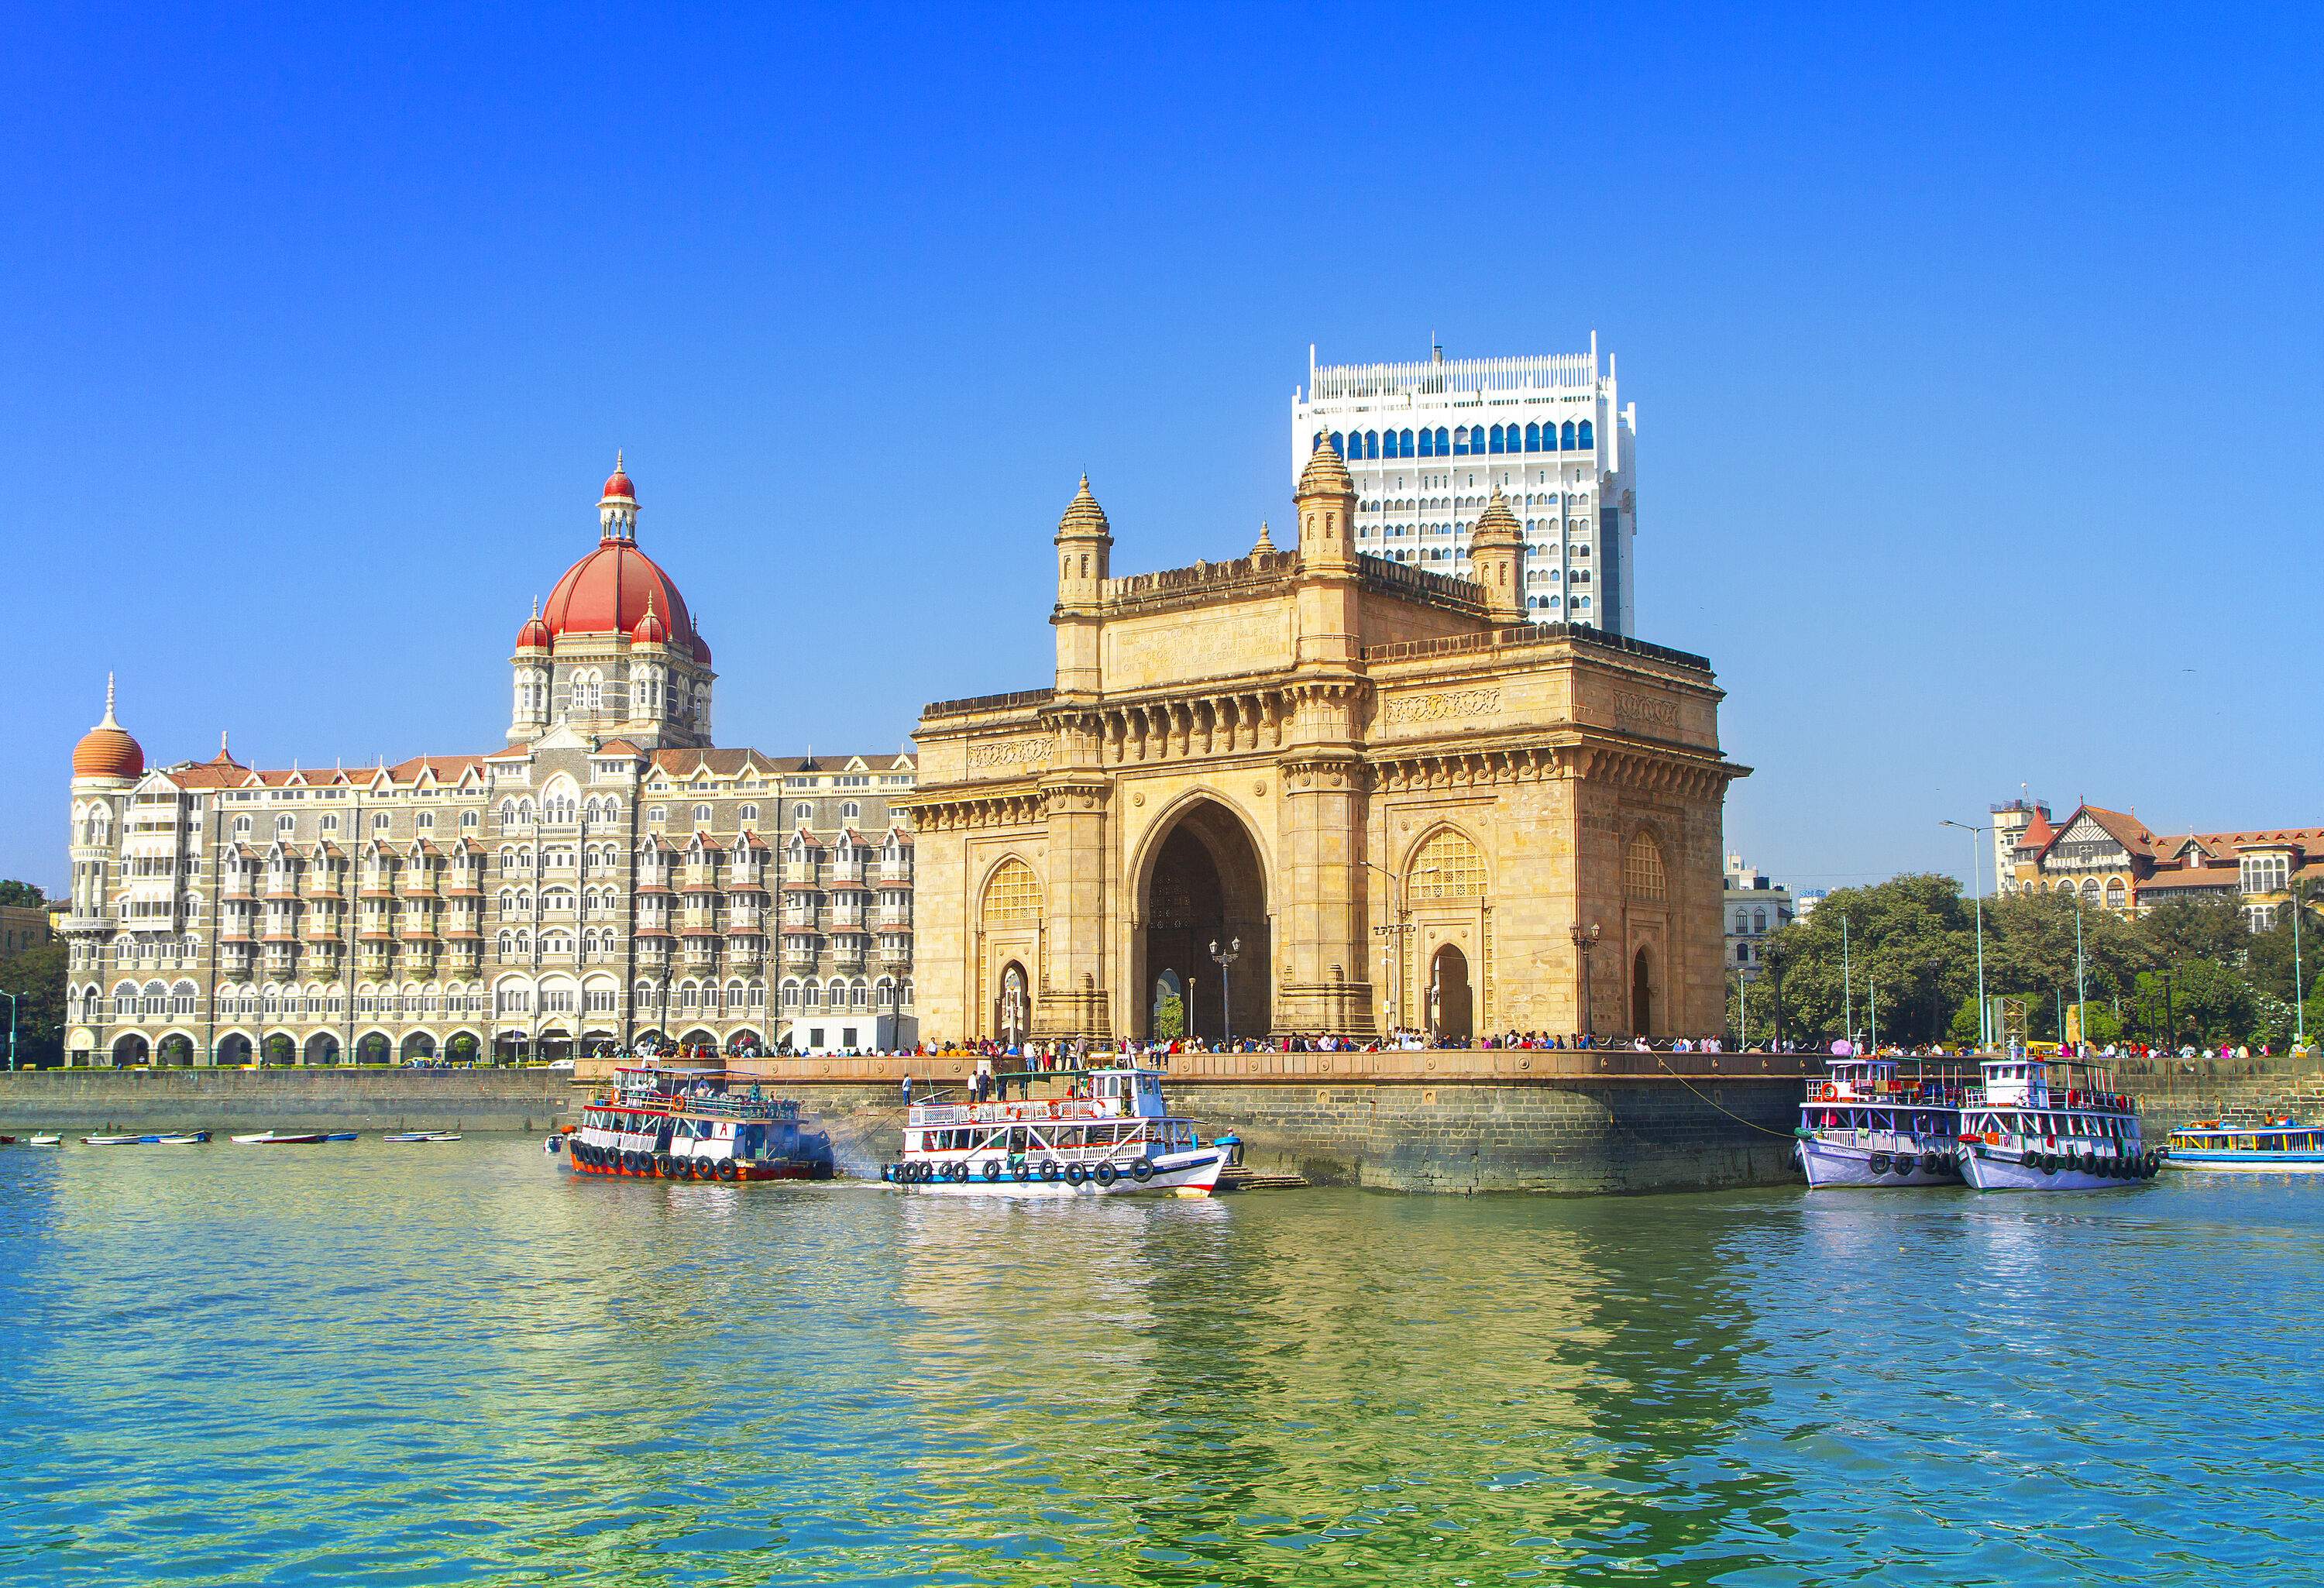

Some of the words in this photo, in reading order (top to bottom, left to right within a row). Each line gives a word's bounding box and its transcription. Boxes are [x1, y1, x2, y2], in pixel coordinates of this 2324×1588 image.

[1231, 620, 1243, 631] THE
[1134, 643, 1151, 651] IDA
[1123, 663, 1134, 672] ON
[1138, 661, 1150, 670] THE
[720, 1122, 727, 1136] A
